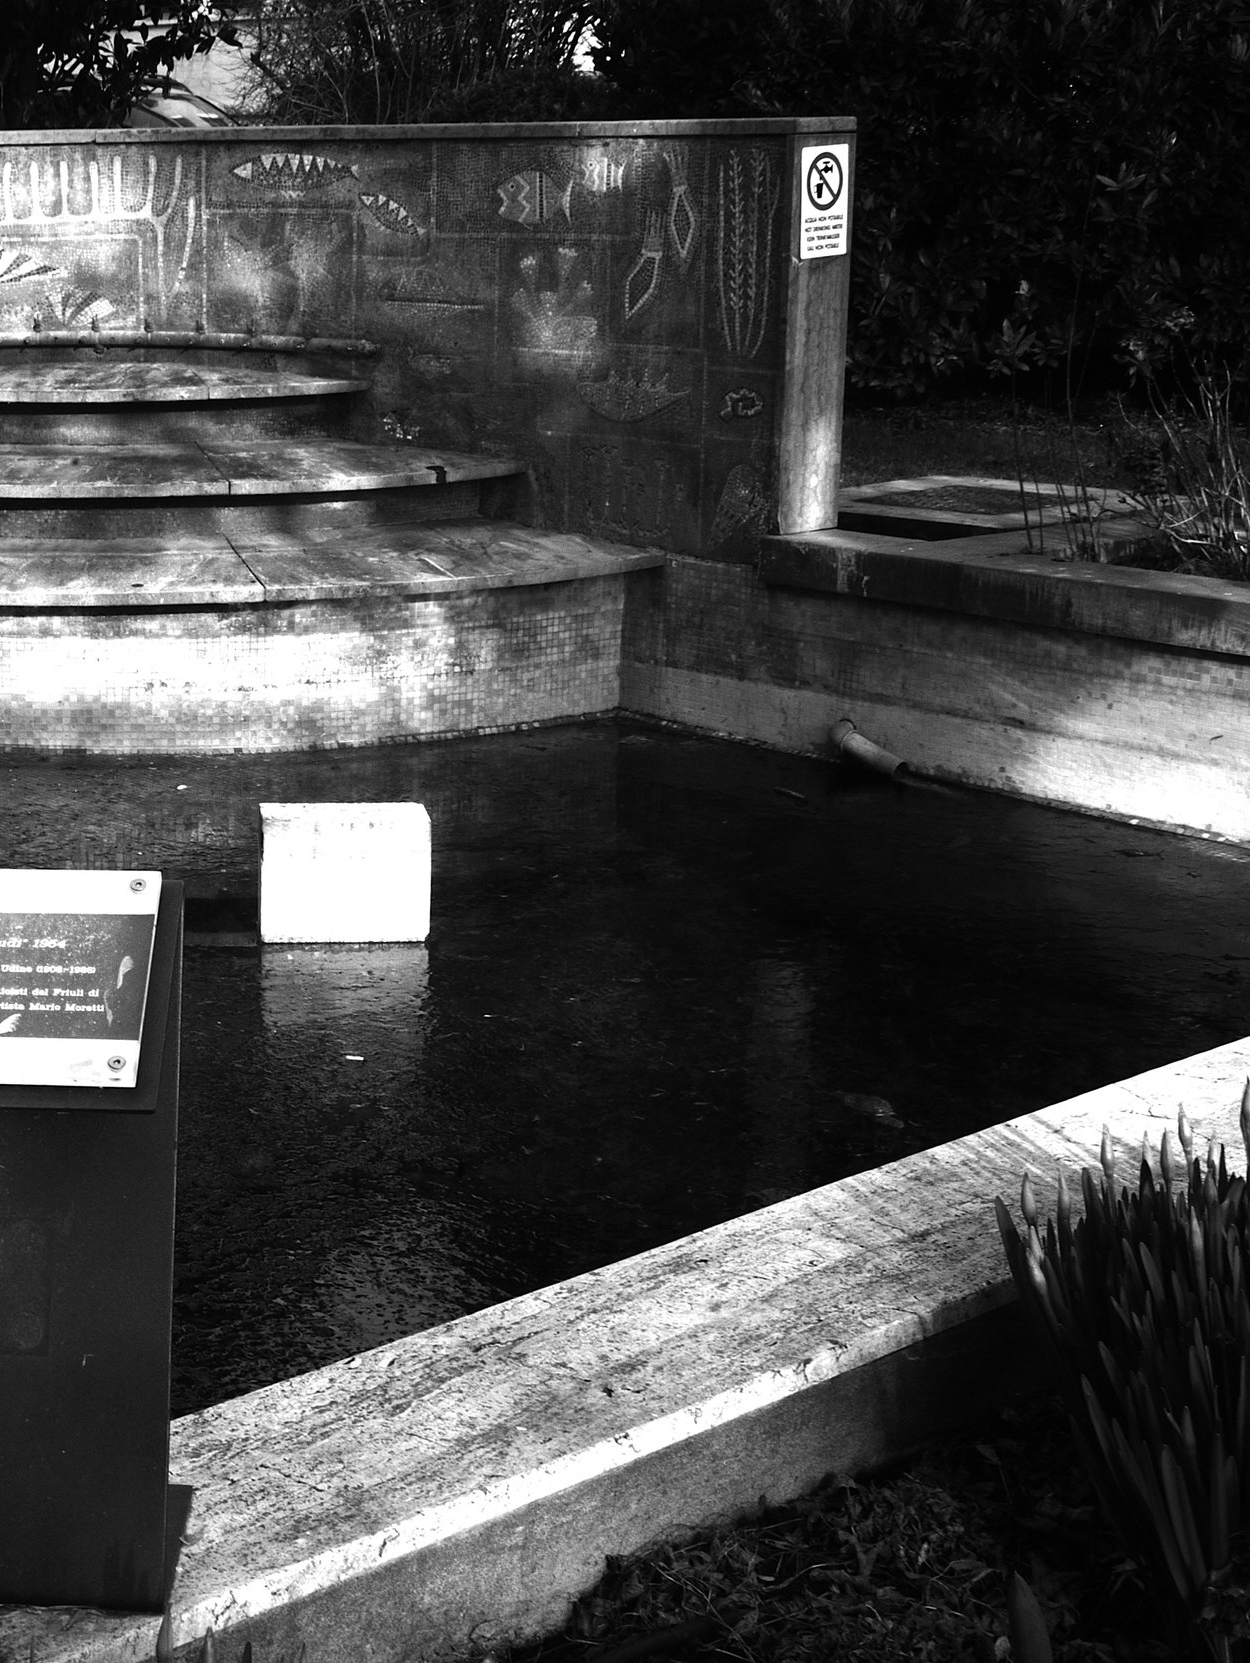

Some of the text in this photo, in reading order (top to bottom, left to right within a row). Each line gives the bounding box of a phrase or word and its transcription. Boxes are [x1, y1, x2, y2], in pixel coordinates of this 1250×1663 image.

[0, 964, 32, 973] Udine
[31, 988, 48, 997] del
[52, 988, 84, 997] Friuli
[88, 988, 99, 997] di
[28, 1002, 61, 1011] Mario
[65, 1003, 105, 1012] Moretti
